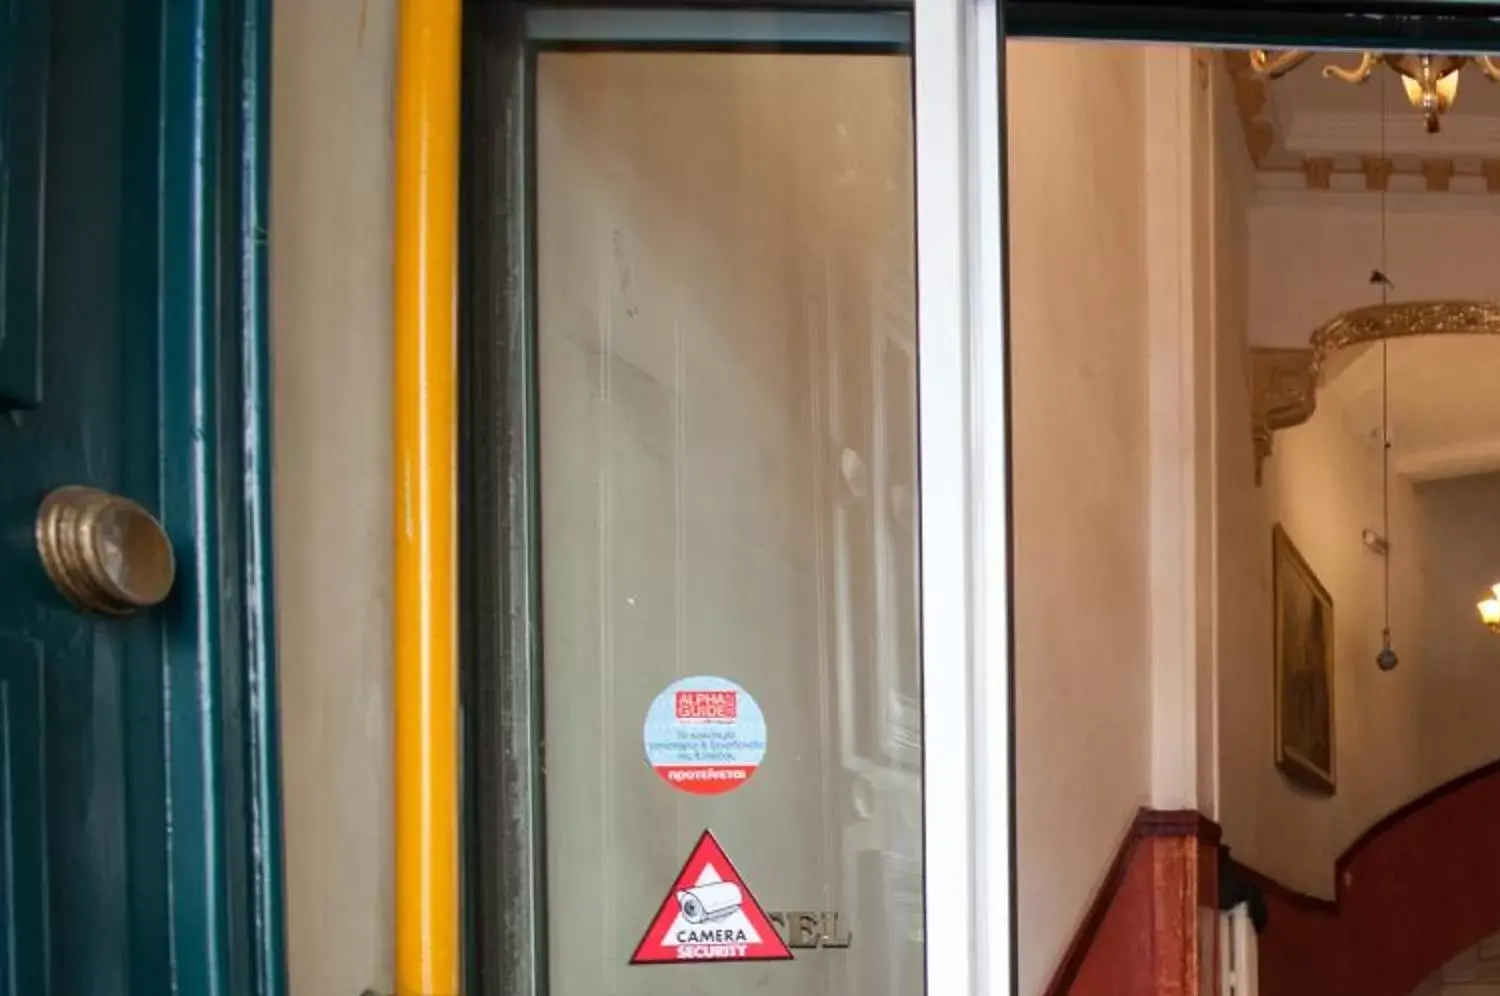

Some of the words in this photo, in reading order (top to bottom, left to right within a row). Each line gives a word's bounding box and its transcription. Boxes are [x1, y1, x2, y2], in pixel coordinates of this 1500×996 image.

[680, 705, 725, 717] GUIDE
[677, 929, 747, 944] CAMERA
[676, 944, 748, 959] SECURITY
